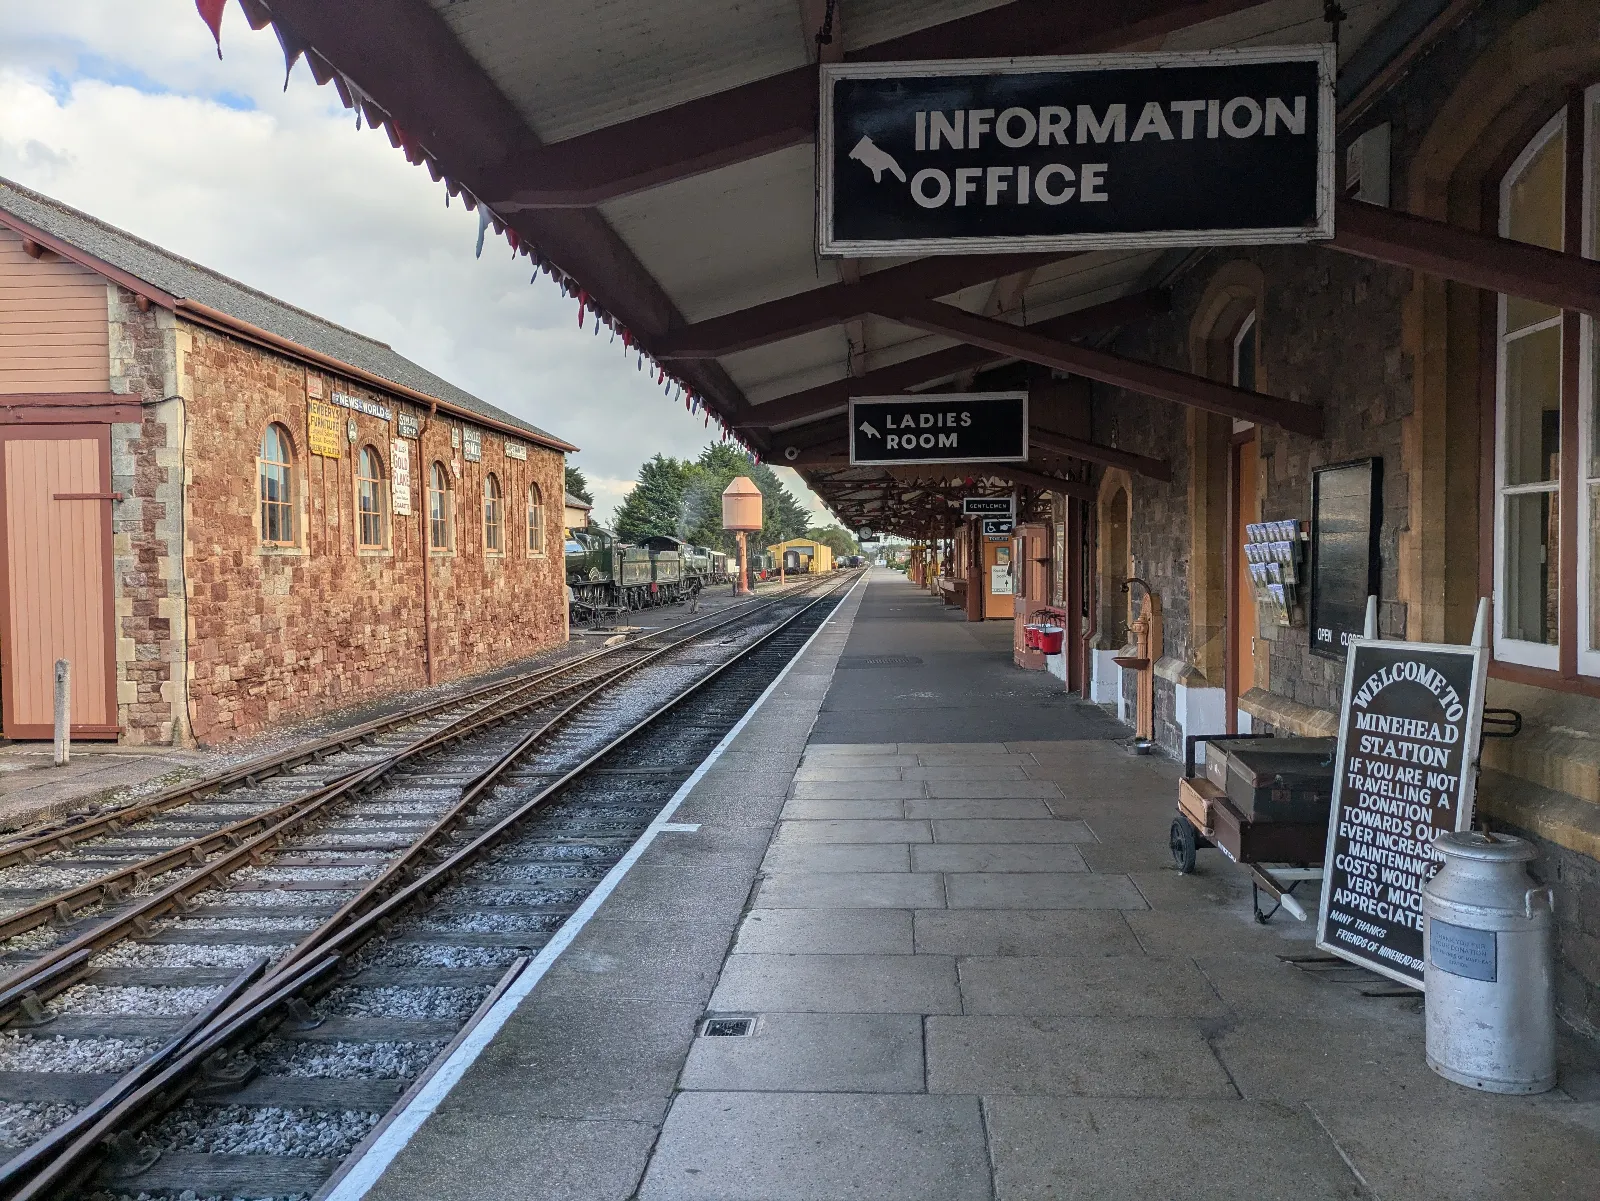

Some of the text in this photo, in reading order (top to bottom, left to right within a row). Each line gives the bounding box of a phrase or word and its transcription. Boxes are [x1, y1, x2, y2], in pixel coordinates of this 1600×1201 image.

[915, 96, 1307, 151] INFORMATION
[911, 163, 1109, 208] OFFICE
[339, 393, 358, 409] NEWS
[362, 401, 386, 418] WORLD
[886, 412, 972, 429] LADIES
[886, 433, 958, 449] ROOM
[393, 454, 408, 471] GOLD
[1317, 628, 1333, 643] OPEN
[1352, 661, 1464, 722] WELCOME TO
[1355, 711, 1459, 744] MINEHEAD
[1360, 735, 1452, 769] STATION
[1349, 756, 1458, 792] IF YOU ARE NOT
[1347, 773, 1432, 805] TRAVELLING
[1437, 793, 1450, 810] A
[1343, 806, 1413, 837] TOWARDS
[1358, 793, 1433, 824] DONATION
[1339, 822, 1447, 863] EVER INCREASIN
[1335, 854, 1378, 880] COSTS
[1347, 874, 1384, 898] VERY
[1329, 909, 1387, 939] MANY THANKS
[1333, 888, 1424, 932] APPRECIATE
[1335, 928, 1369, 948] FRIENDS
[1367, 941, 1380, 953] OF
[1378, 945, 1413, 967] MINEHEAD
[1450, 945, 1487, 957] DONATION
